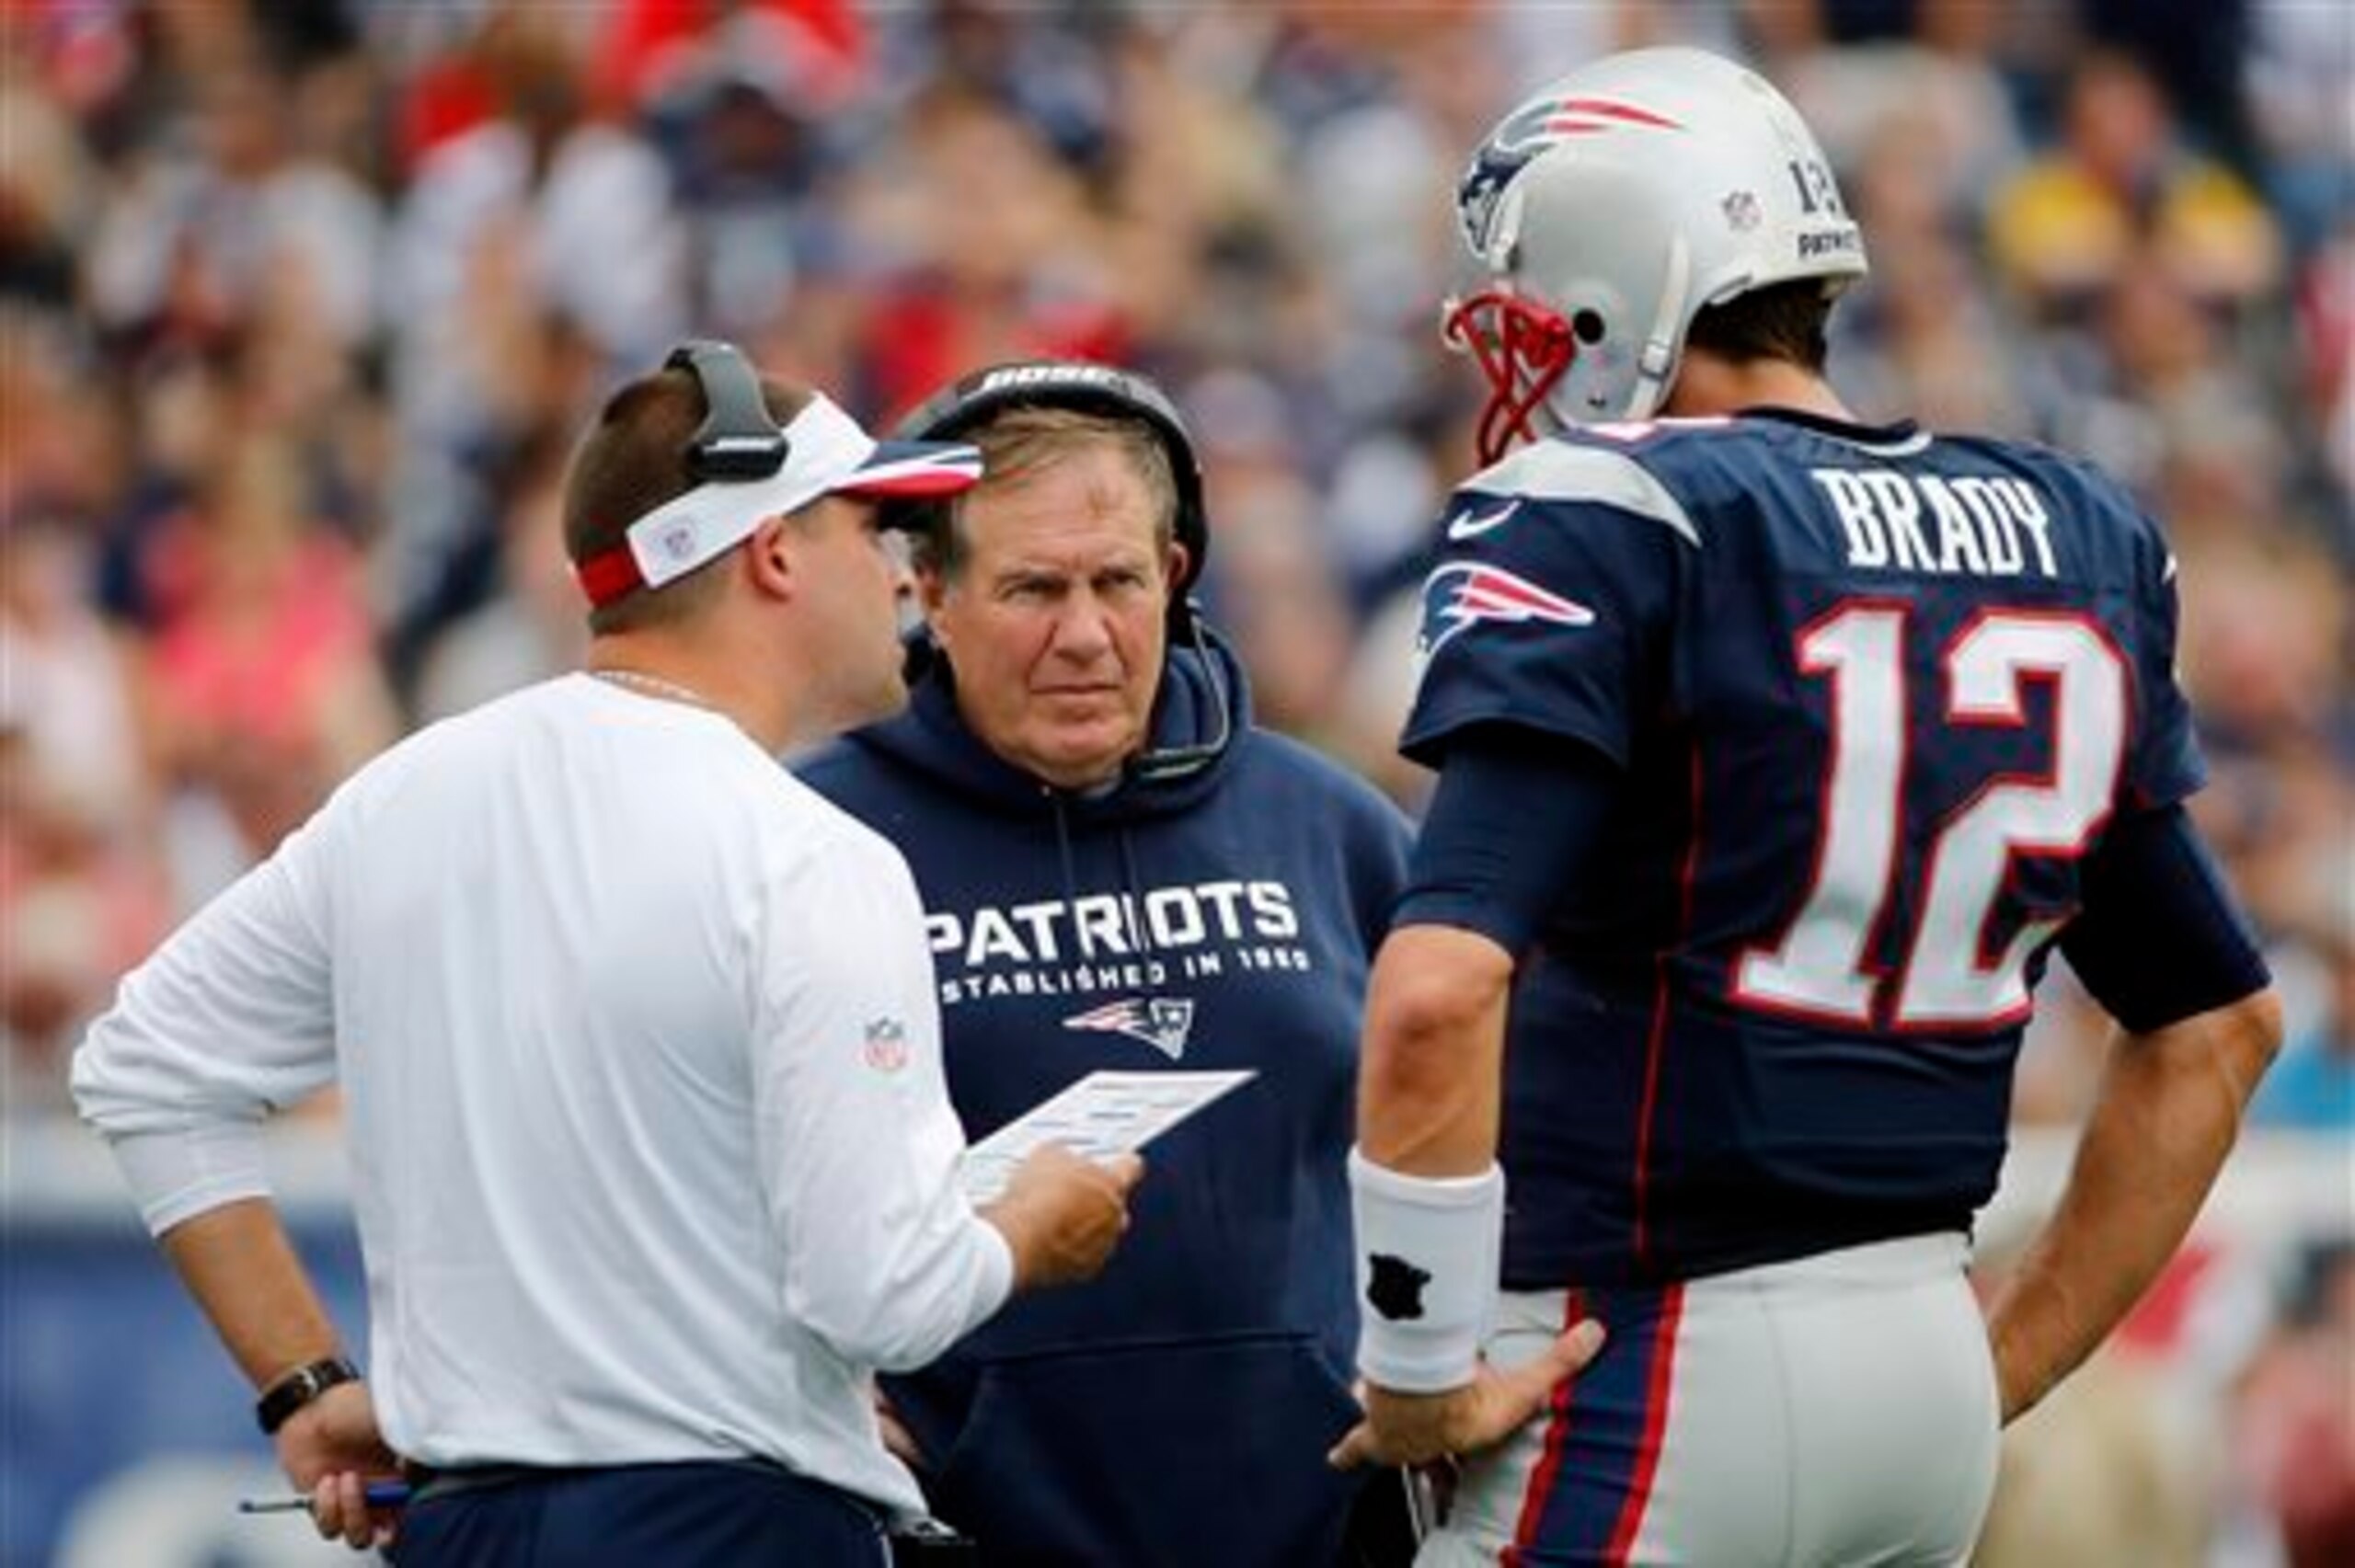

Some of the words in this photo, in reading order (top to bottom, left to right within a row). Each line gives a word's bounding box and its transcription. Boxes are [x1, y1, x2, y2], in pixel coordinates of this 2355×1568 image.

[1809, 468, 2059, 577] BRADY
[1728, 596, 2134, 1034] 12
[924, 880, 1299, 966] PATRIOTS
[940, 963, 1166, 1004] STABLISHED
[1183, 952, 1221, 979] IN
